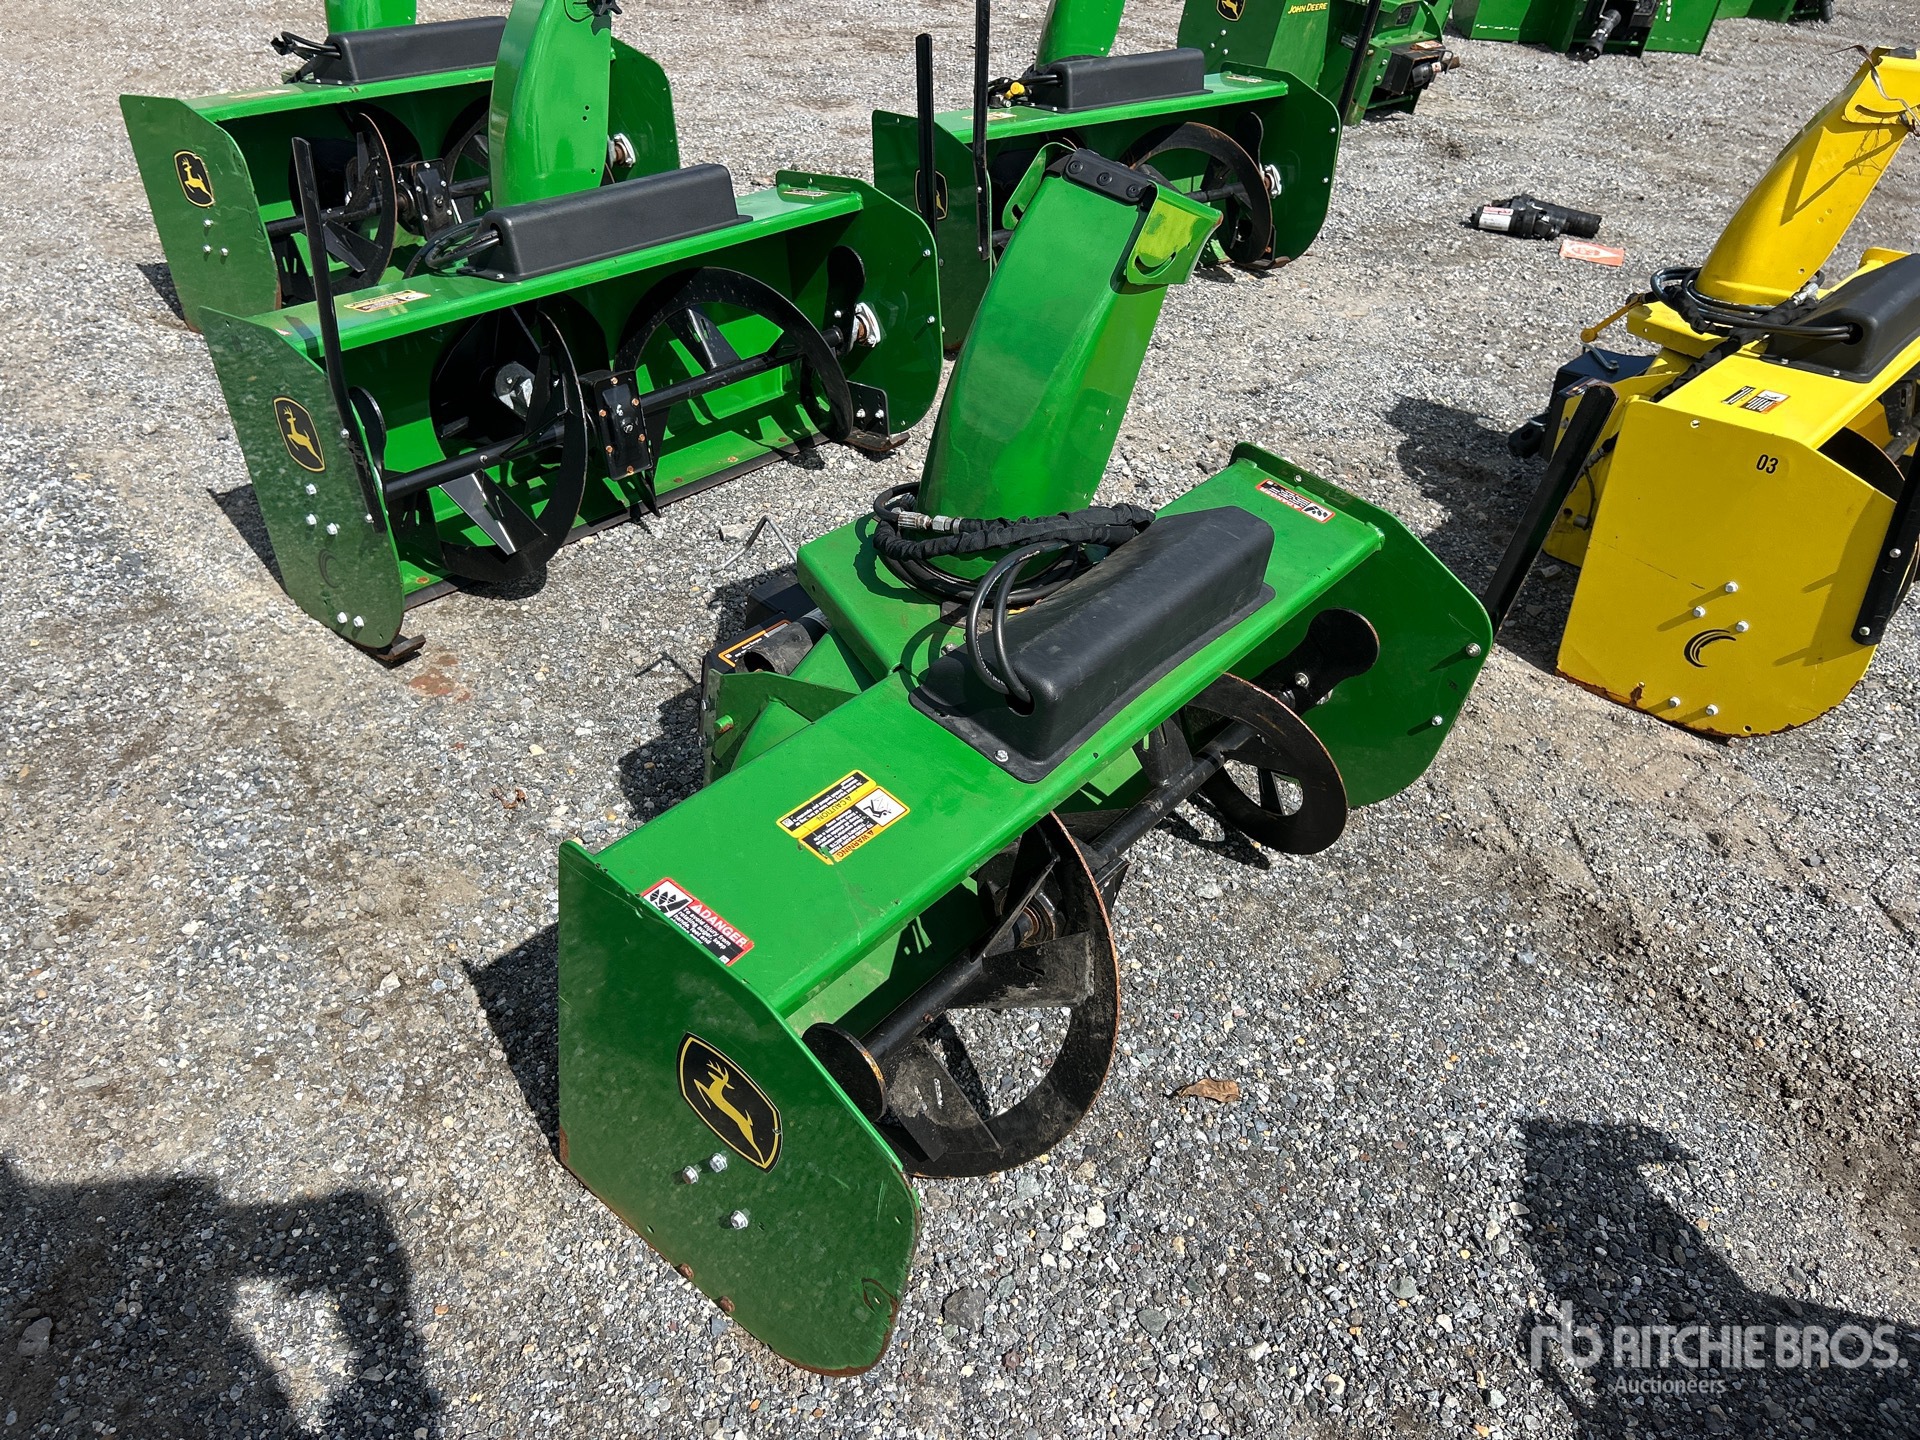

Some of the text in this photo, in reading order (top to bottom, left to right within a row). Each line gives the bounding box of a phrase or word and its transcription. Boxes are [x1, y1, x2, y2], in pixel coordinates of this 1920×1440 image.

[1288, 2, 1328, 14] JOHN DEERE
[1756, 454, 1779, 475] 03
[816, 799, 847, 821] CAUTION
[836, 834, 869, 858] WARNING
[683, 907, 692, 915] To
[689, 912, 705, 925] avoid
[717, 934, 732, 946] from
[700, 909, 749, 947] DANGER
